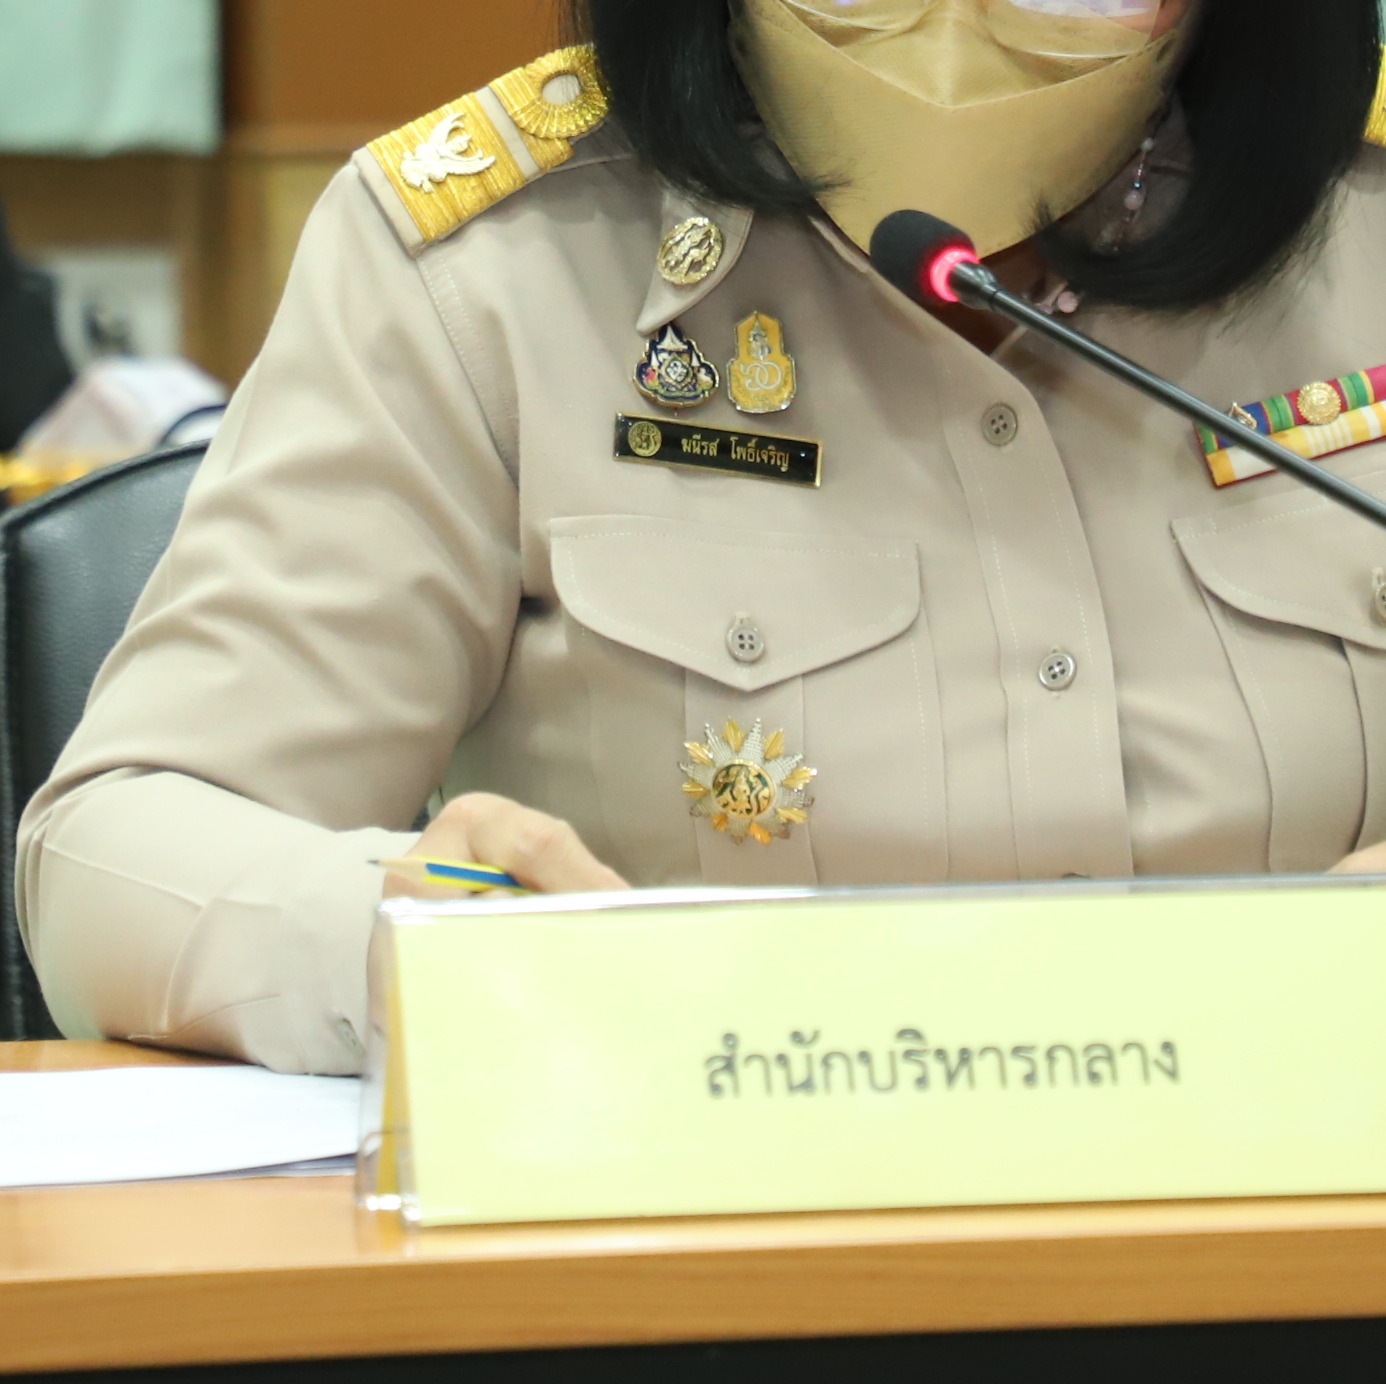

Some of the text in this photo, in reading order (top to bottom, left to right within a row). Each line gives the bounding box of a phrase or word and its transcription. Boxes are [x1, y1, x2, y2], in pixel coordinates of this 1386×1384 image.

[729, 436, 790, 473] โพธิ์เจริญ
[705, 1027, 1179, 1096] สำนักบริหารกลาง
